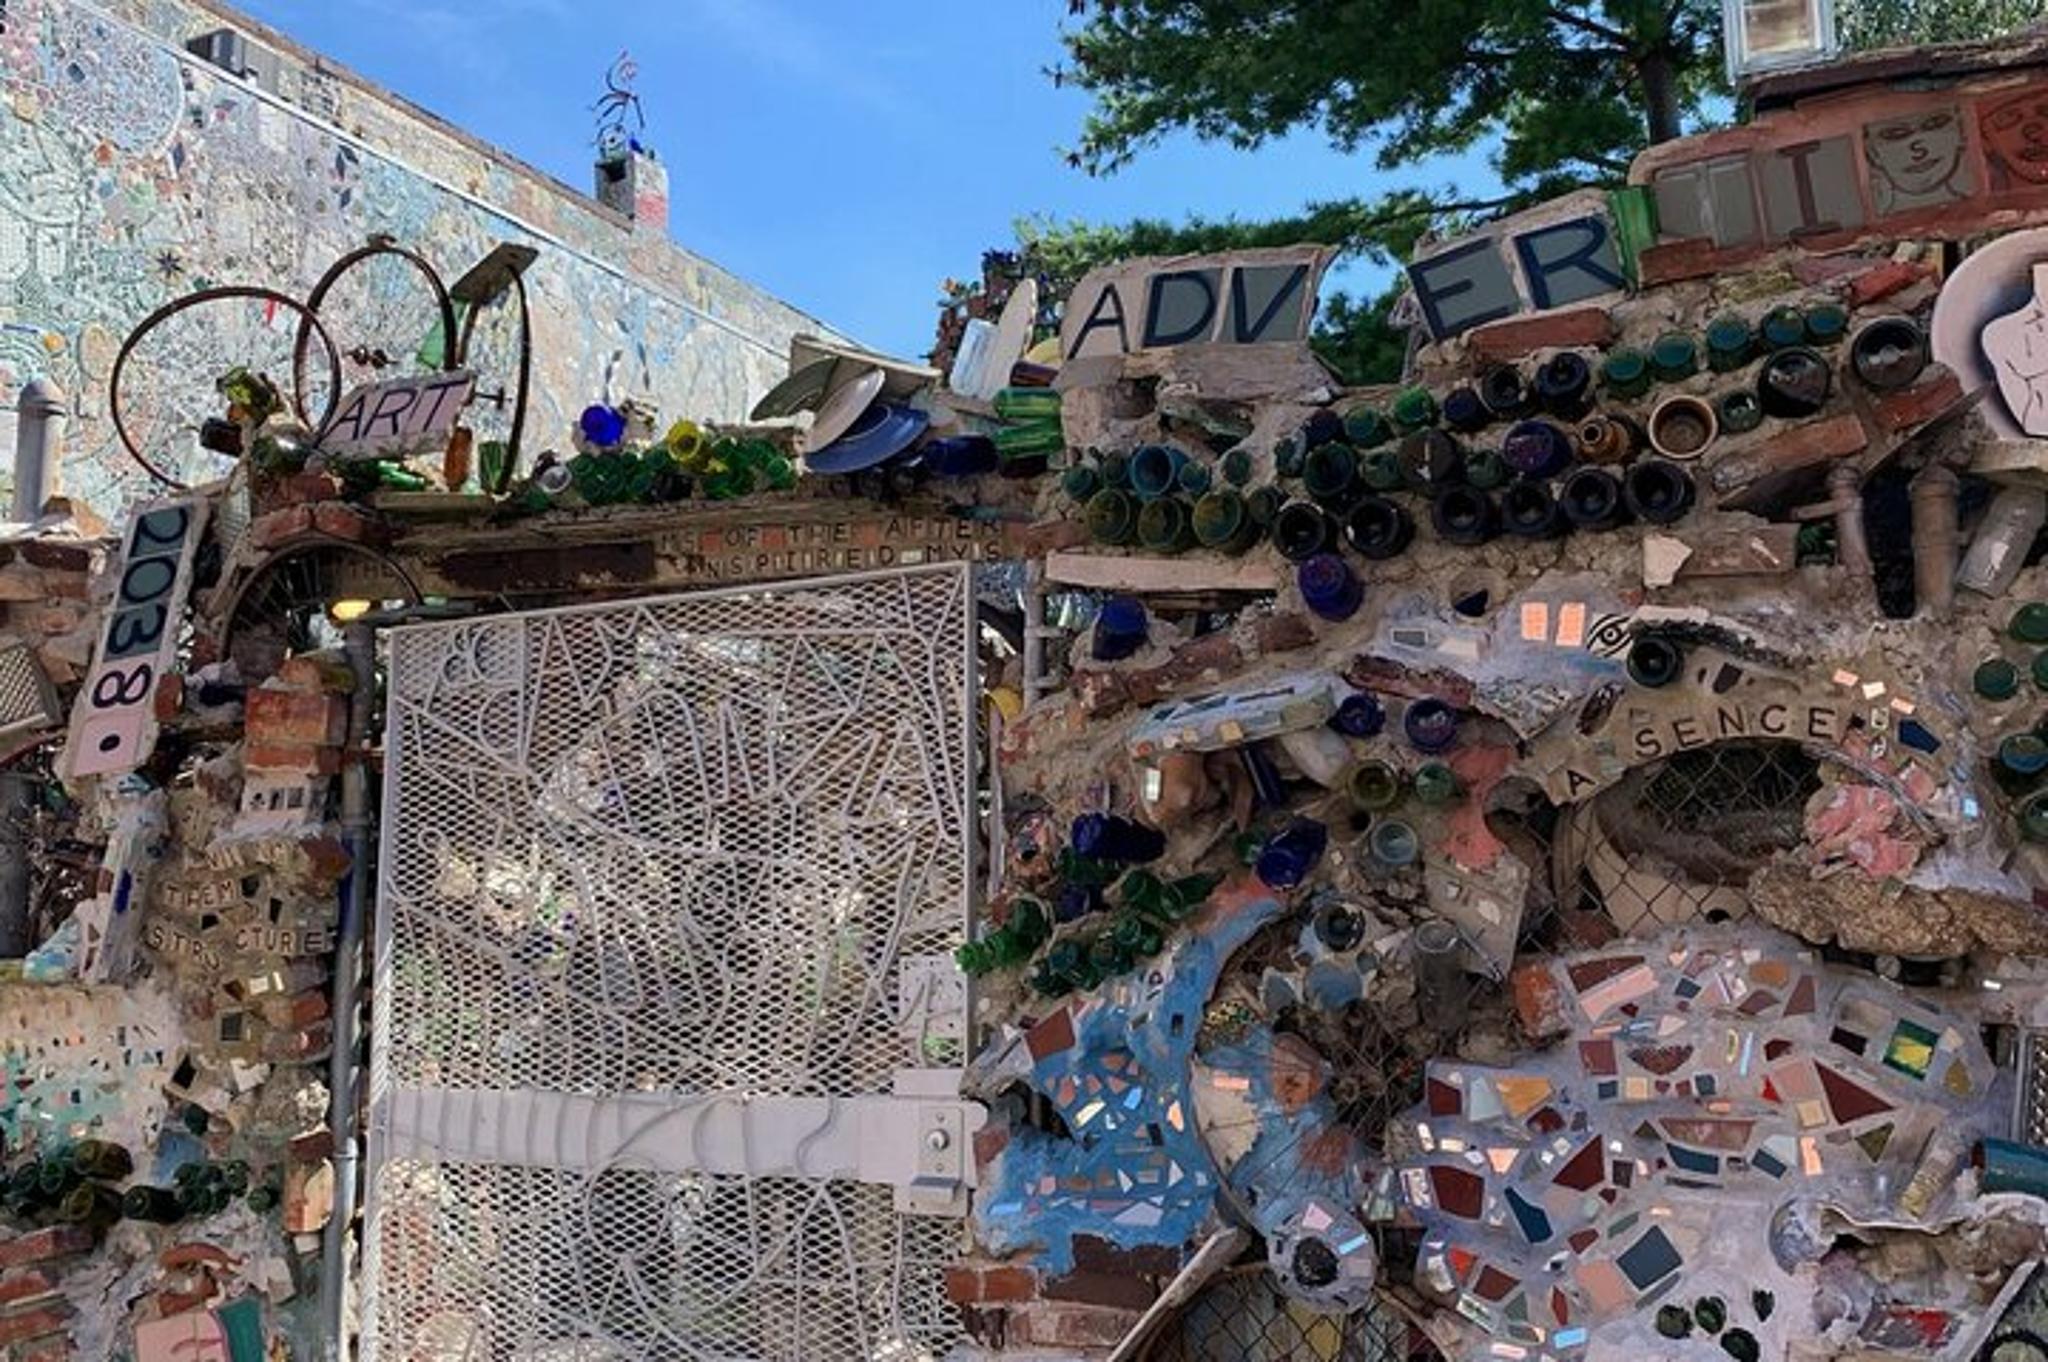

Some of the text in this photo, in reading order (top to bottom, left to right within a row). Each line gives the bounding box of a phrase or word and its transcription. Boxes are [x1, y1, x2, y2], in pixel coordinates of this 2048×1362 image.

[312, 378, 470, 450] ART
[724, 526, 758, 548] OF
[789, 522, 848, 543] THE
[1634, 703, 1837, 758] SENCE
